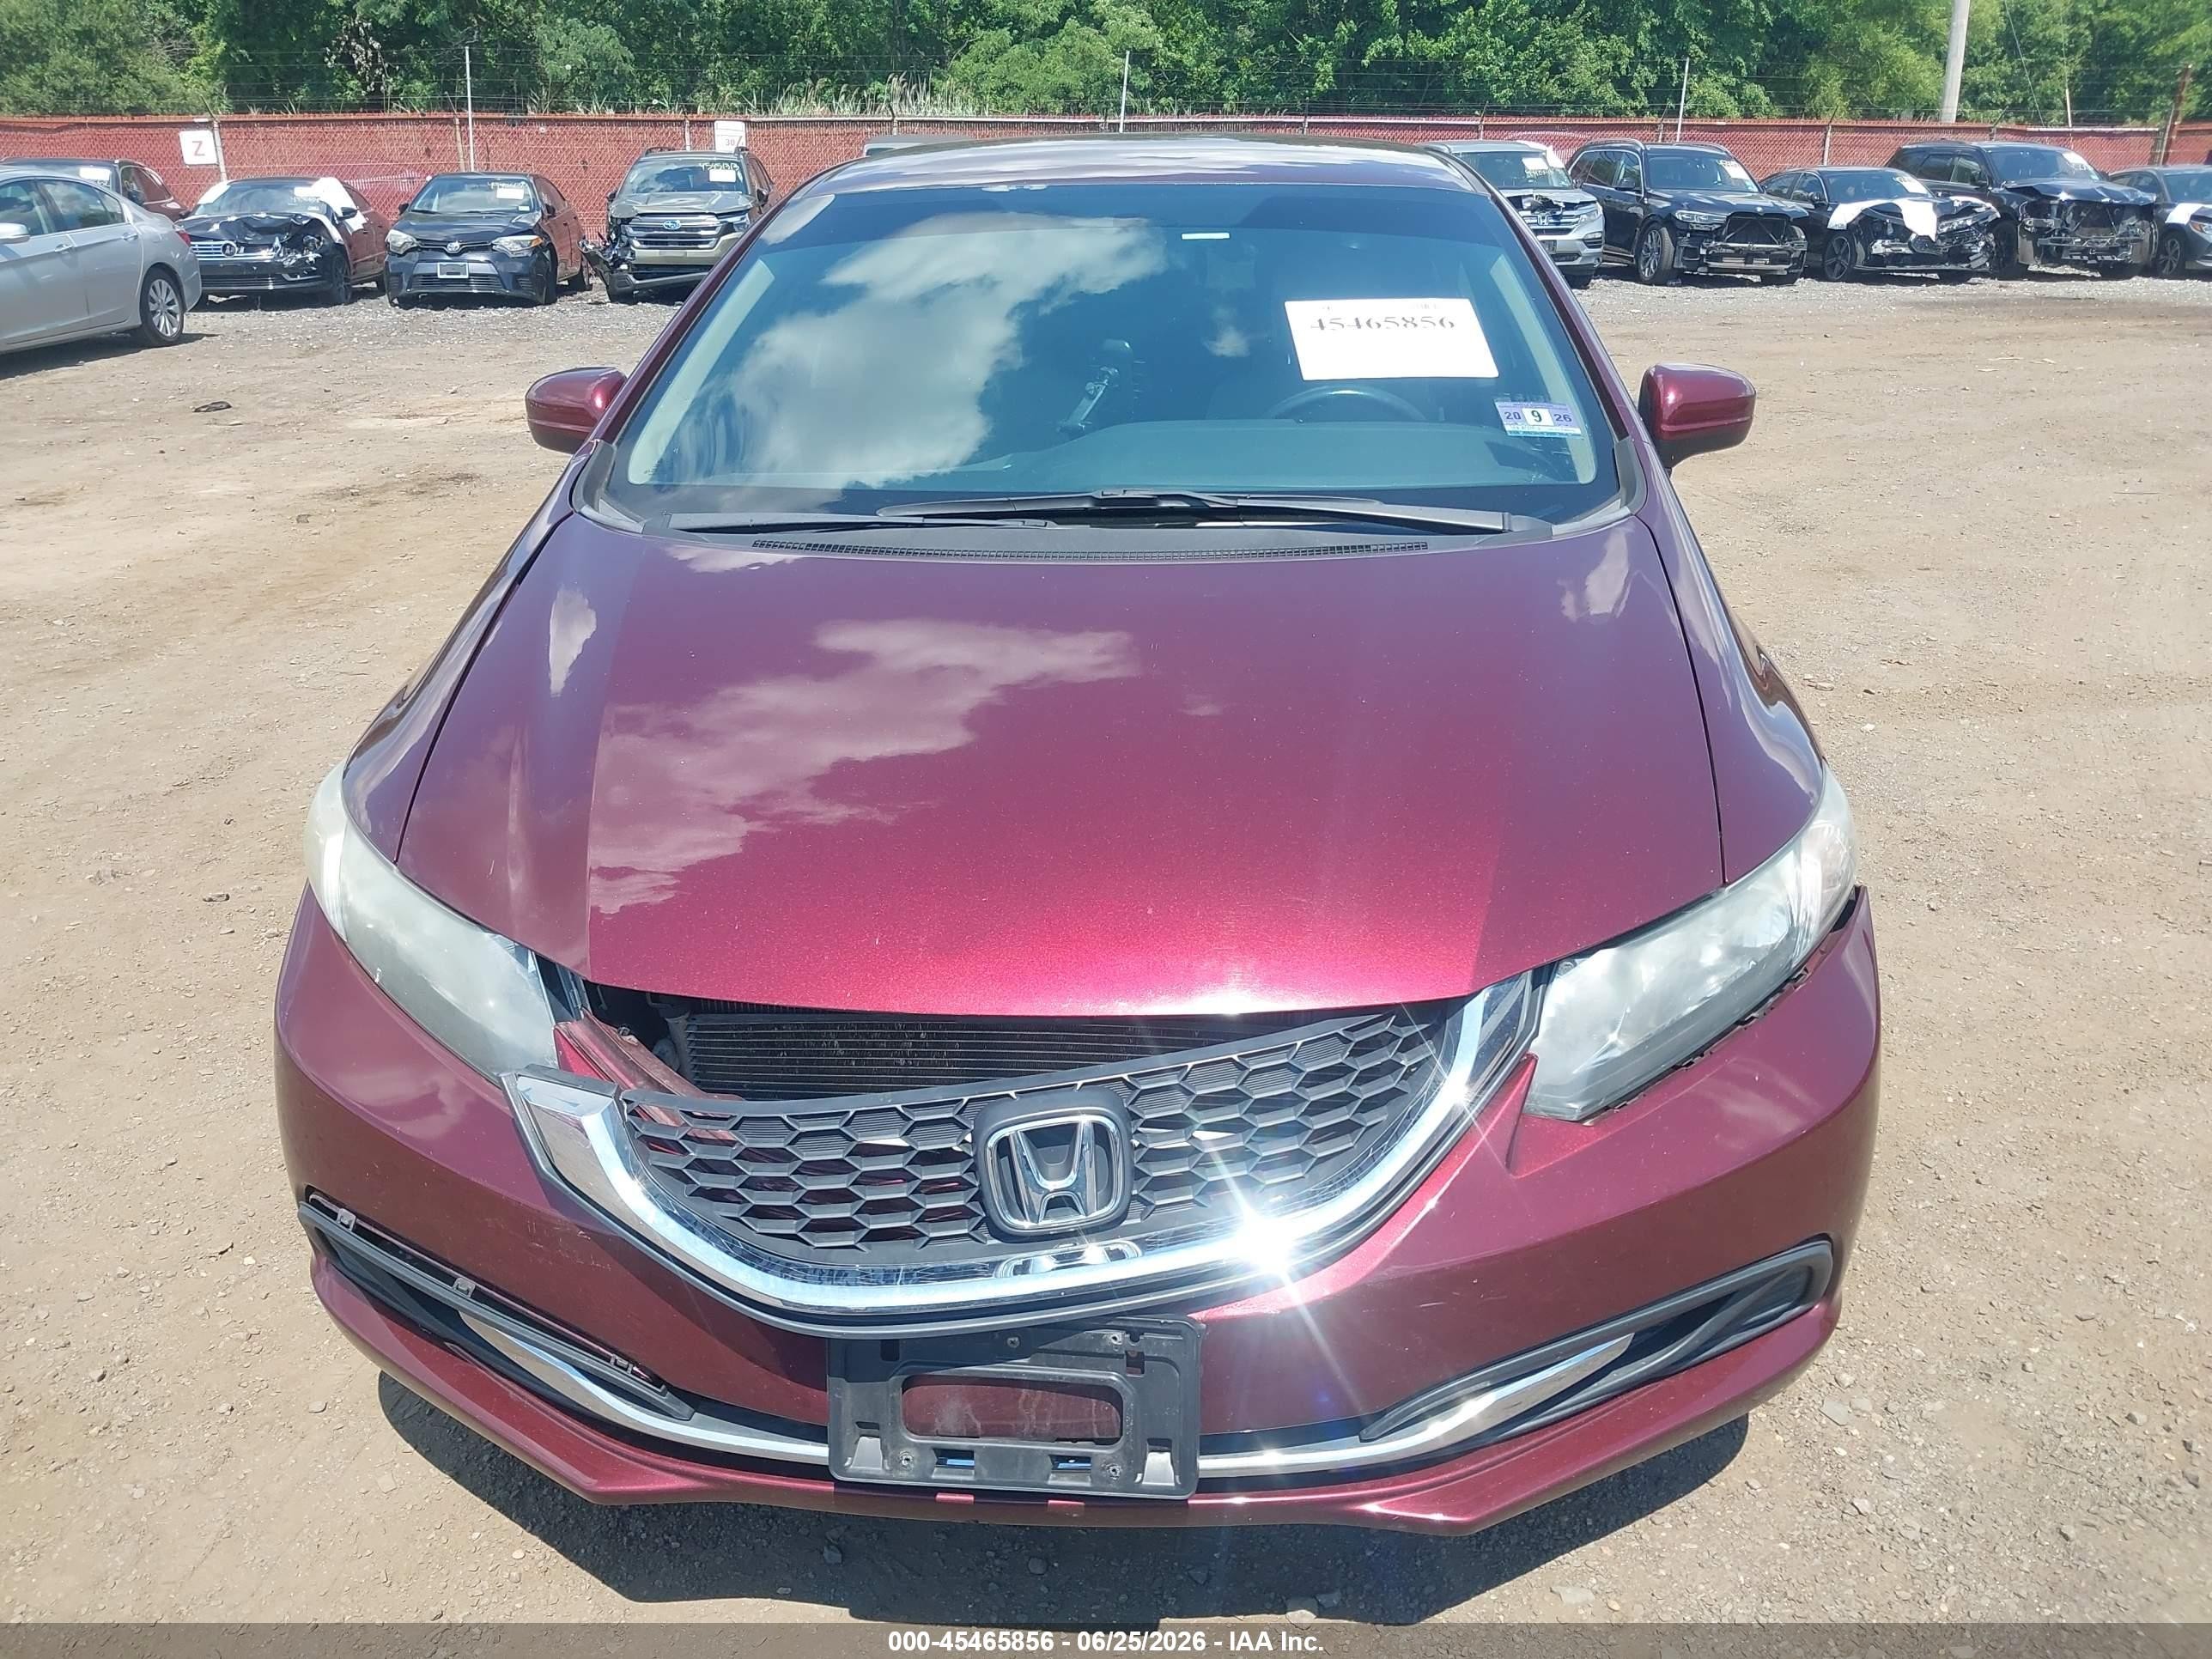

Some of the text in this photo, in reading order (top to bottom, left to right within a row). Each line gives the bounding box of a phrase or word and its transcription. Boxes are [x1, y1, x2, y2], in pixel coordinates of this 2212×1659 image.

[191, 140, 206, 156] Z
[1310, 315, 1455, 331] 45465856
[1504, 410, 1573, 422] 20 9 26
